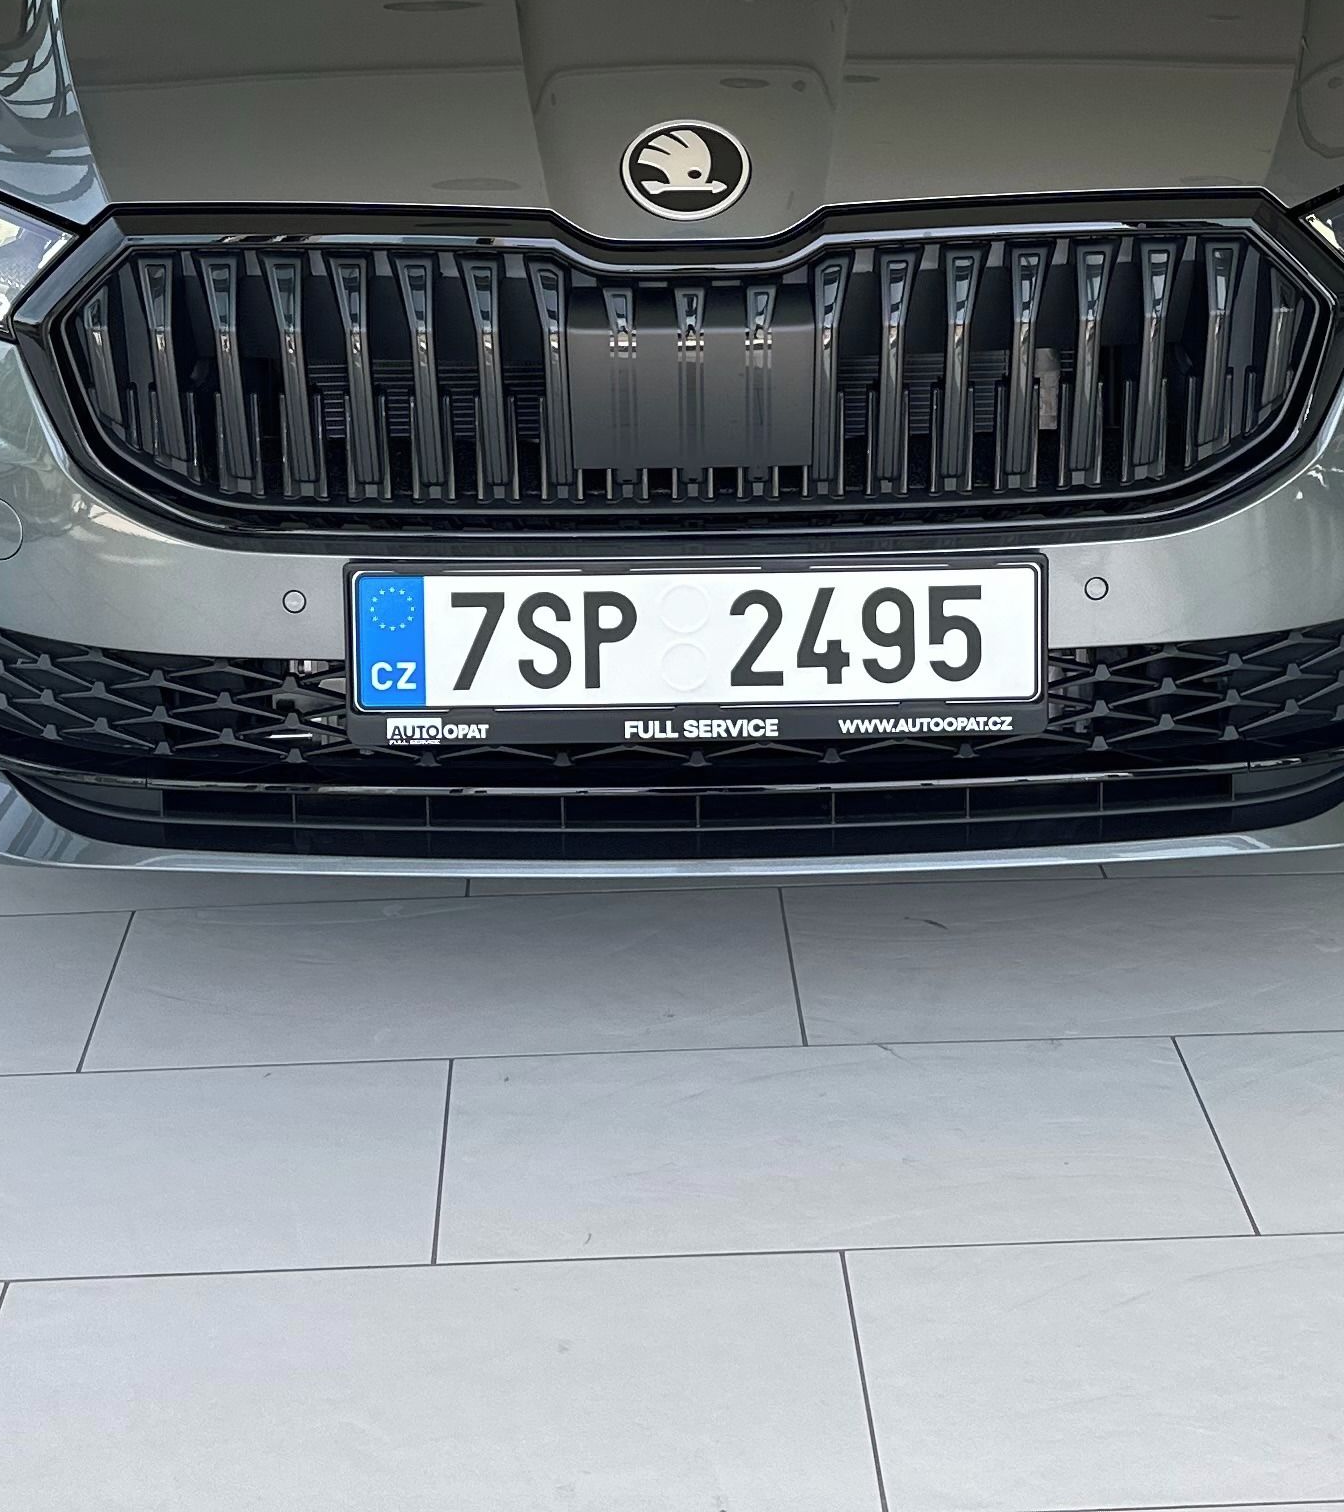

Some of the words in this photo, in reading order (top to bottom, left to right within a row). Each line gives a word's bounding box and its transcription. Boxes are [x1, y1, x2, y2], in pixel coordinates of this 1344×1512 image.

[451, 591, 637, 691] 7SP
[729, 584, 982, 687] 2495
[371, 661, 417, 691] CZ
[624, 720, 679, 739] FULL
[683, 718, 779, 738] SERVICE
[838, 716, 1013, 734] WWW.AUTOOPAT.CZ
